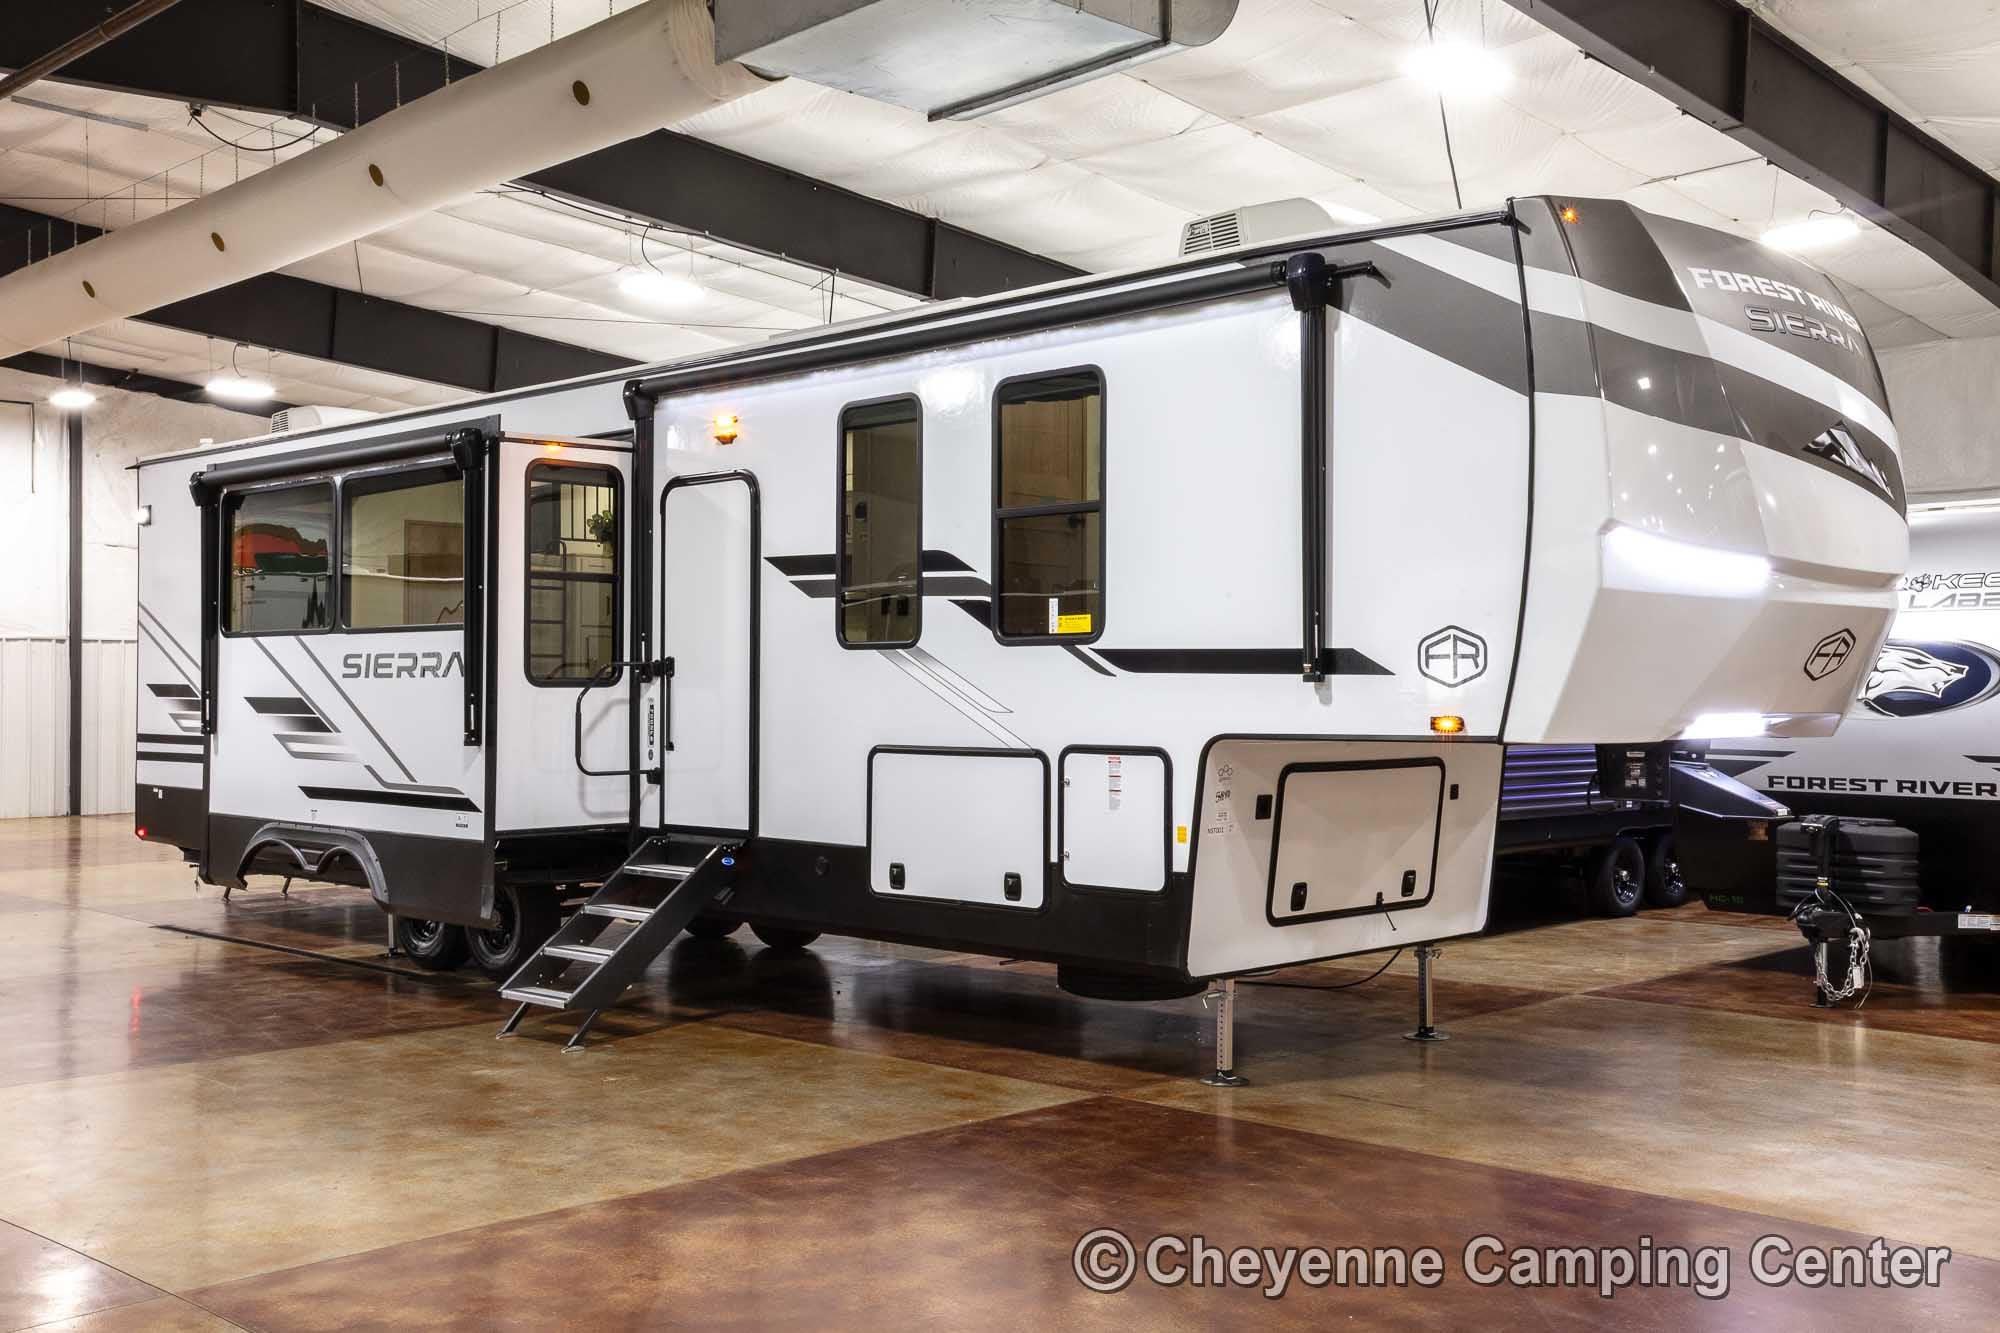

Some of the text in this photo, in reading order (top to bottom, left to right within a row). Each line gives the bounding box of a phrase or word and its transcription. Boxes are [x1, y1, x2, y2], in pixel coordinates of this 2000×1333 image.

[1687, 267, 1807, 305] FOREST
[1744, 304, 1865, 358] SIERRA
[342, 651, 464, 678] SIERRA
[1767, 775, 1998, 797] FOREST RIVER
